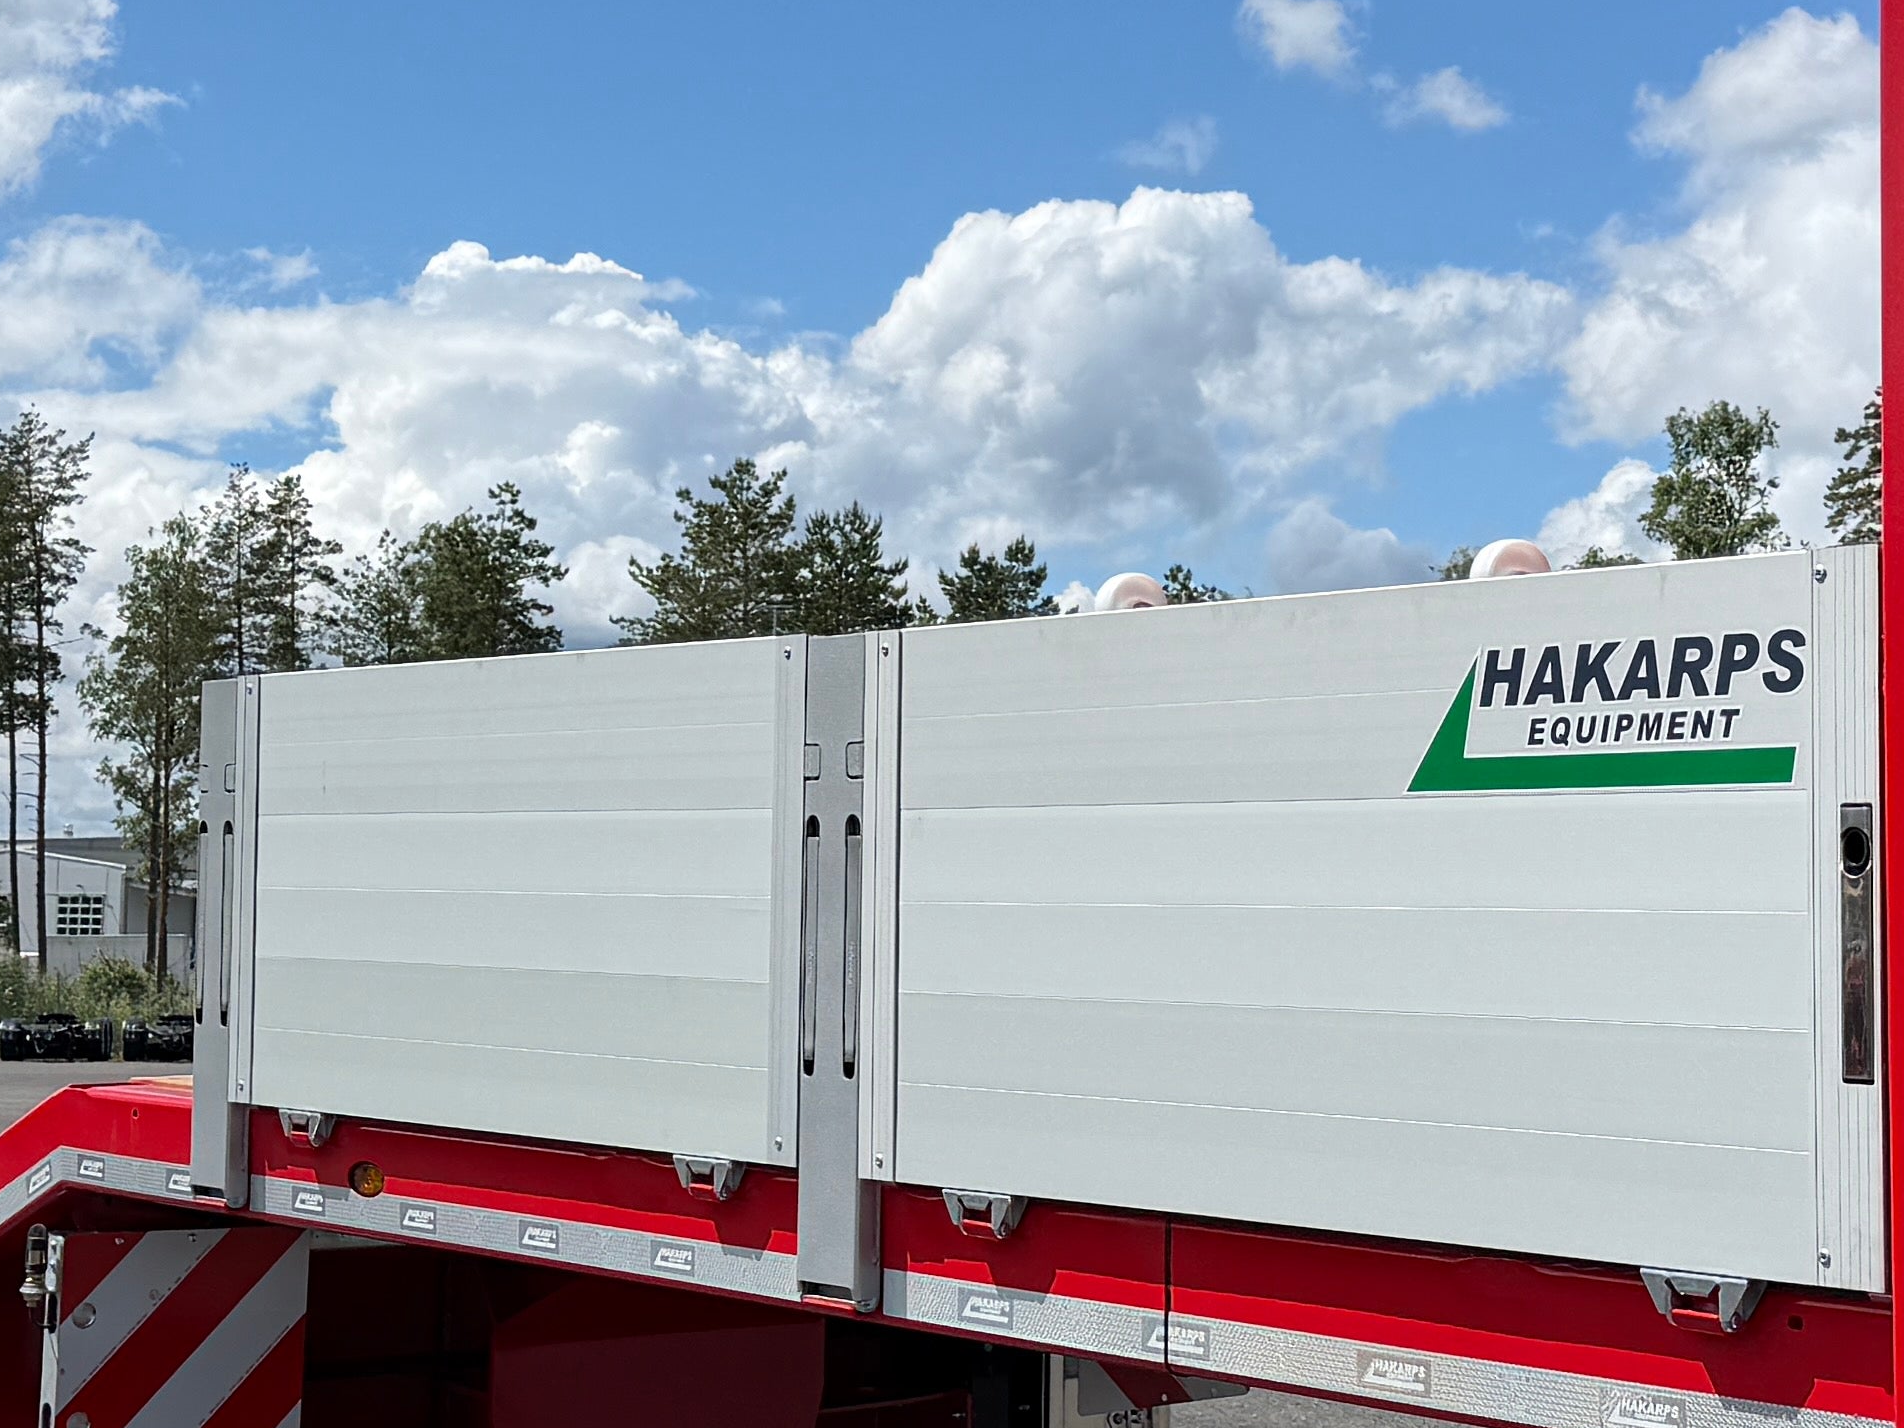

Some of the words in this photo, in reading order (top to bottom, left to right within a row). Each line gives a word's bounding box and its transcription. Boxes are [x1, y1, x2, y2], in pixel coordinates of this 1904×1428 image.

[1479, 629, 1806, 707] HAKARPS
[1527, 709, 1740, 746] EQUIPMENT
[1621, 1397, 1680, 1419] HAKARPS
